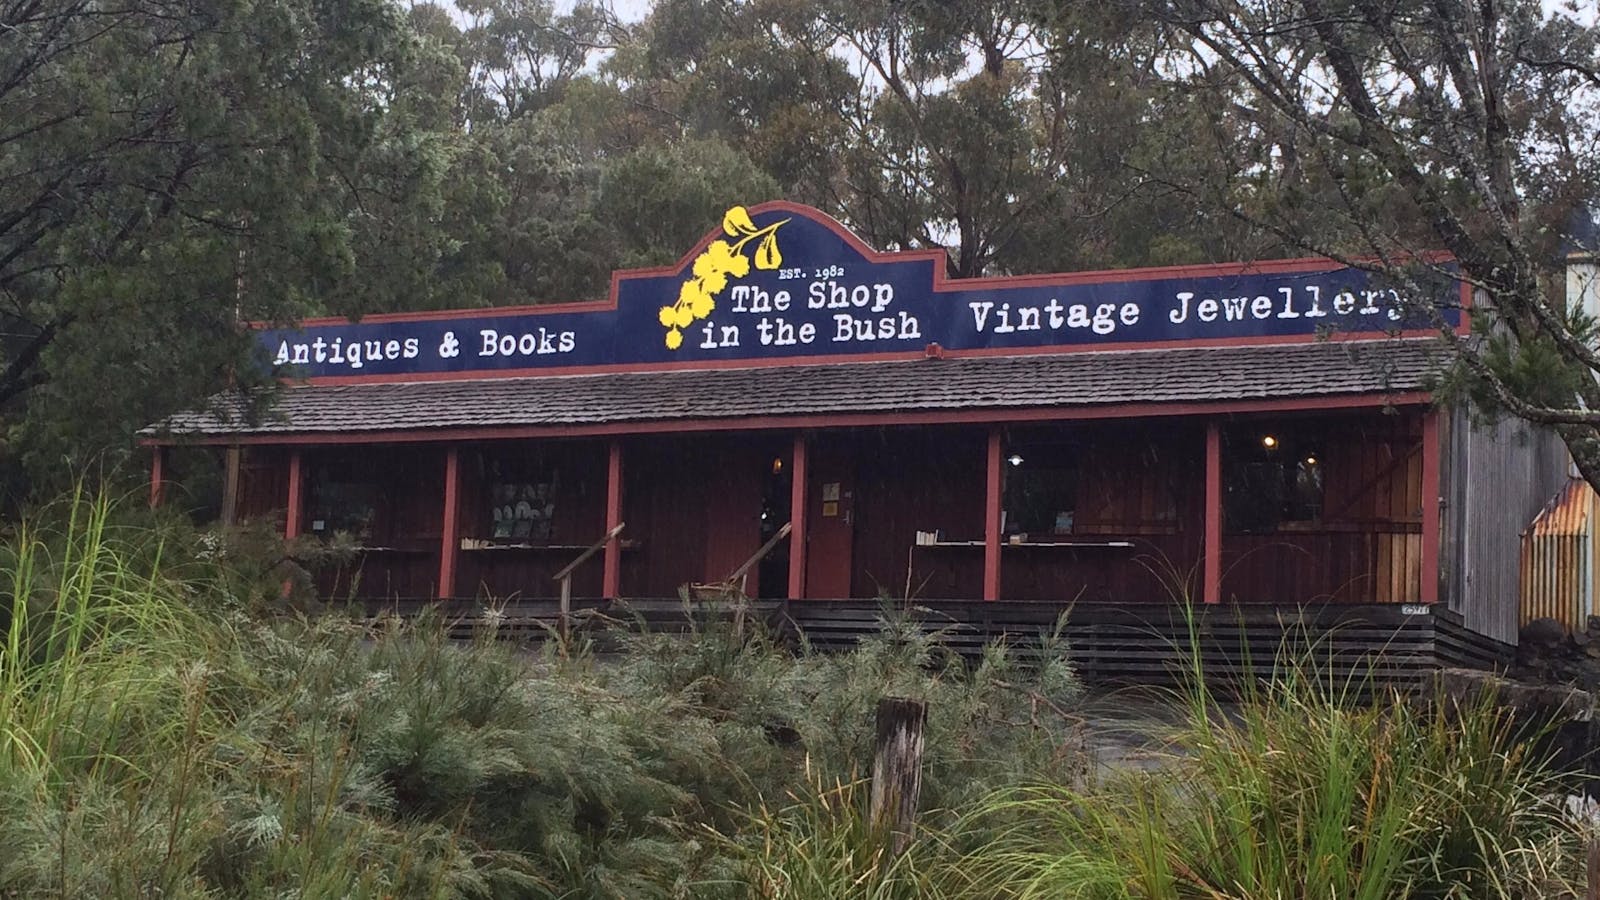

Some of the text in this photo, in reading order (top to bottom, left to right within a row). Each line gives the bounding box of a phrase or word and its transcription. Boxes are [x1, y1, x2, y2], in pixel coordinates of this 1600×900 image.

[778, 265, 845, 280] EST. 1982
[731, 280, 893, 313] The Shop
[700, 312, 921, 349] in the Bush
[969, 299, 1140, 335] Vintage
[273, 328, 576, 368] Antiques & Books
